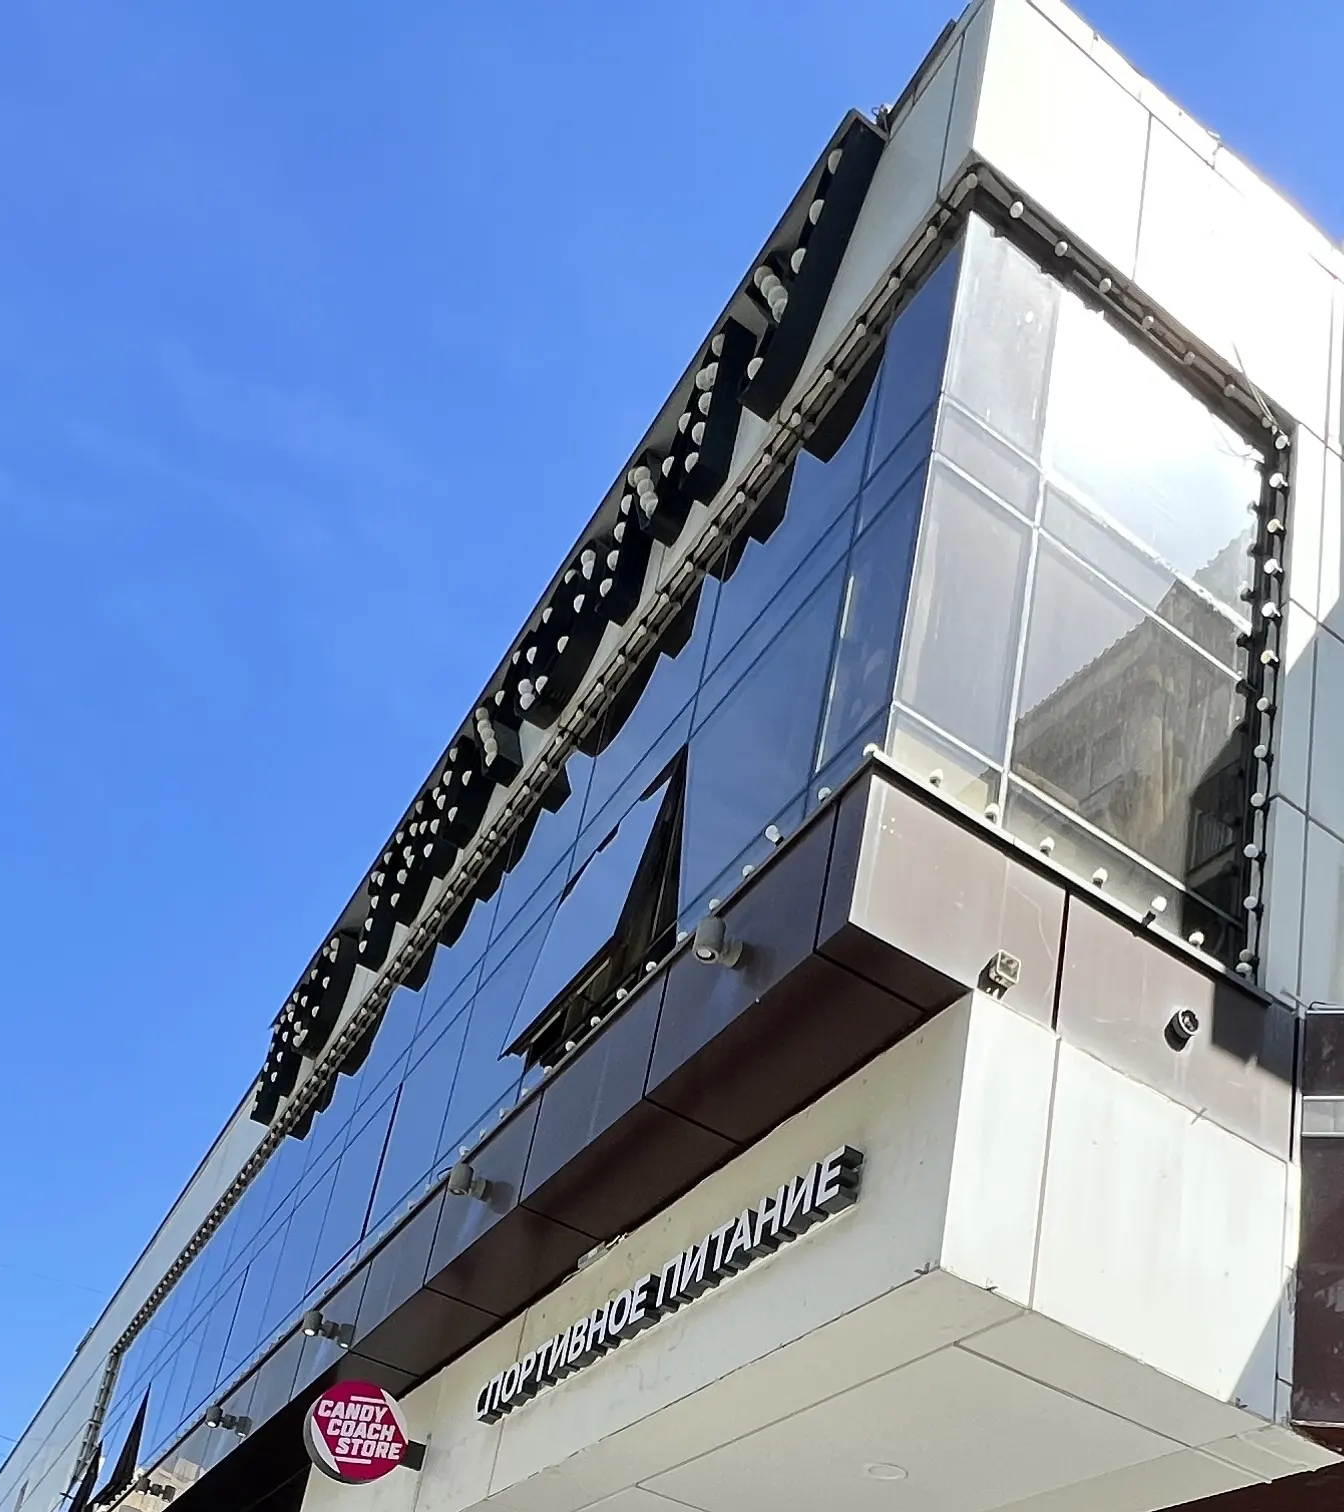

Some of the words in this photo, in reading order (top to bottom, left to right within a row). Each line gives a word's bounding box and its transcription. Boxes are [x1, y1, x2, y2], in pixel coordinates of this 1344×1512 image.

[475, 1273, 657, 1419] СПОРТИВНОЕ
[655, 1145, 852, 1308] ПИТАНИЕ
[317, 1400, 388, 1423] CANDY
[326, 1418, 396, 1441] COACH
[335, 1437, 402, 1460] STORE
